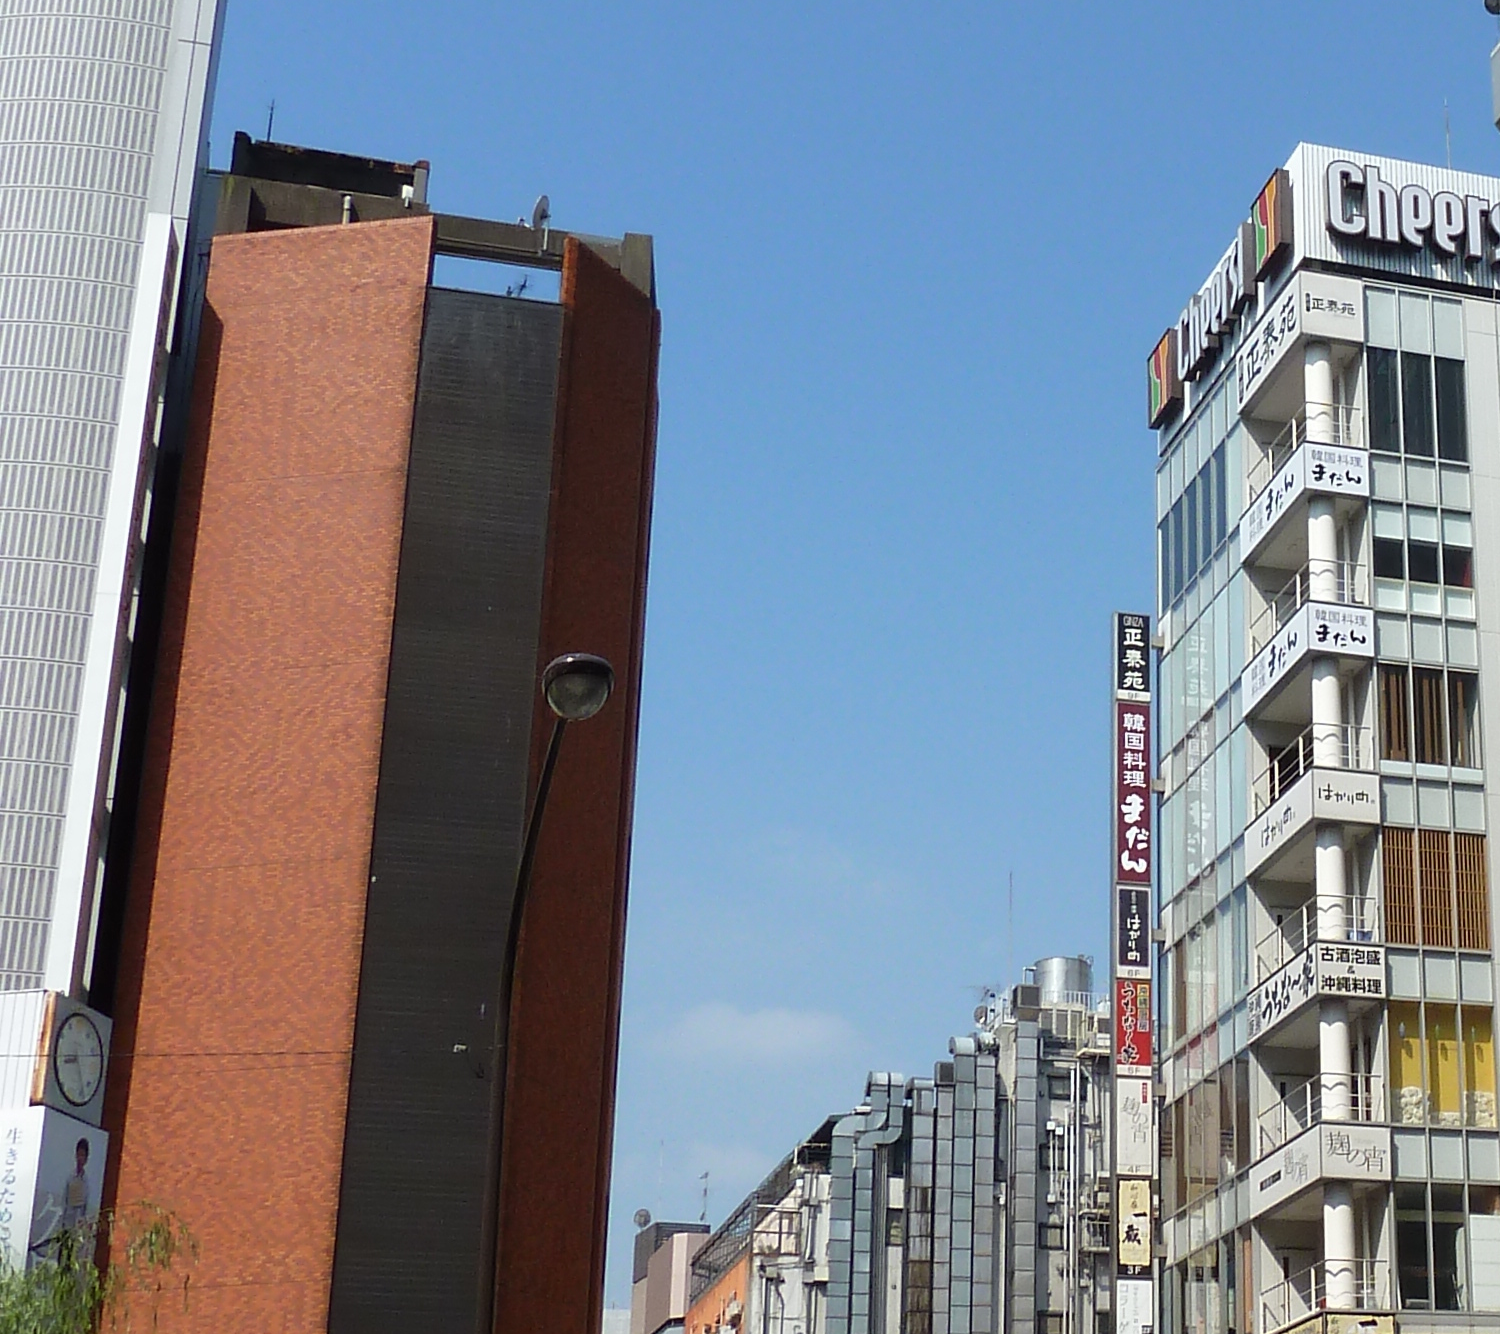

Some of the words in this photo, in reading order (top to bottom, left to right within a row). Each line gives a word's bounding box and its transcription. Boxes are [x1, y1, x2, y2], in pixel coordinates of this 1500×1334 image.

[1311, 297, 1356, 317] 正泰苑
[1244, 293, 1296, 389] 正泰苑
[1311, 449, 1363, 468] 韓国料理
[1311, 463, 1362, 487] まだん
[1314, 608, 1368, 628] 韓国料理
[1315, 623, 1367, 647] まだん
[1123, 628, 1146, 690] 正泰苑
[1123, 712, 1147, 788] 韓国料理
[1121, 793, 1150, 873] まだん
[1320, 947, 1381, 966] 古酒泡盛
[1320, 974, 1383, 995] 沖縄料理
[1127, 1266, 1142, 1275] 3F
